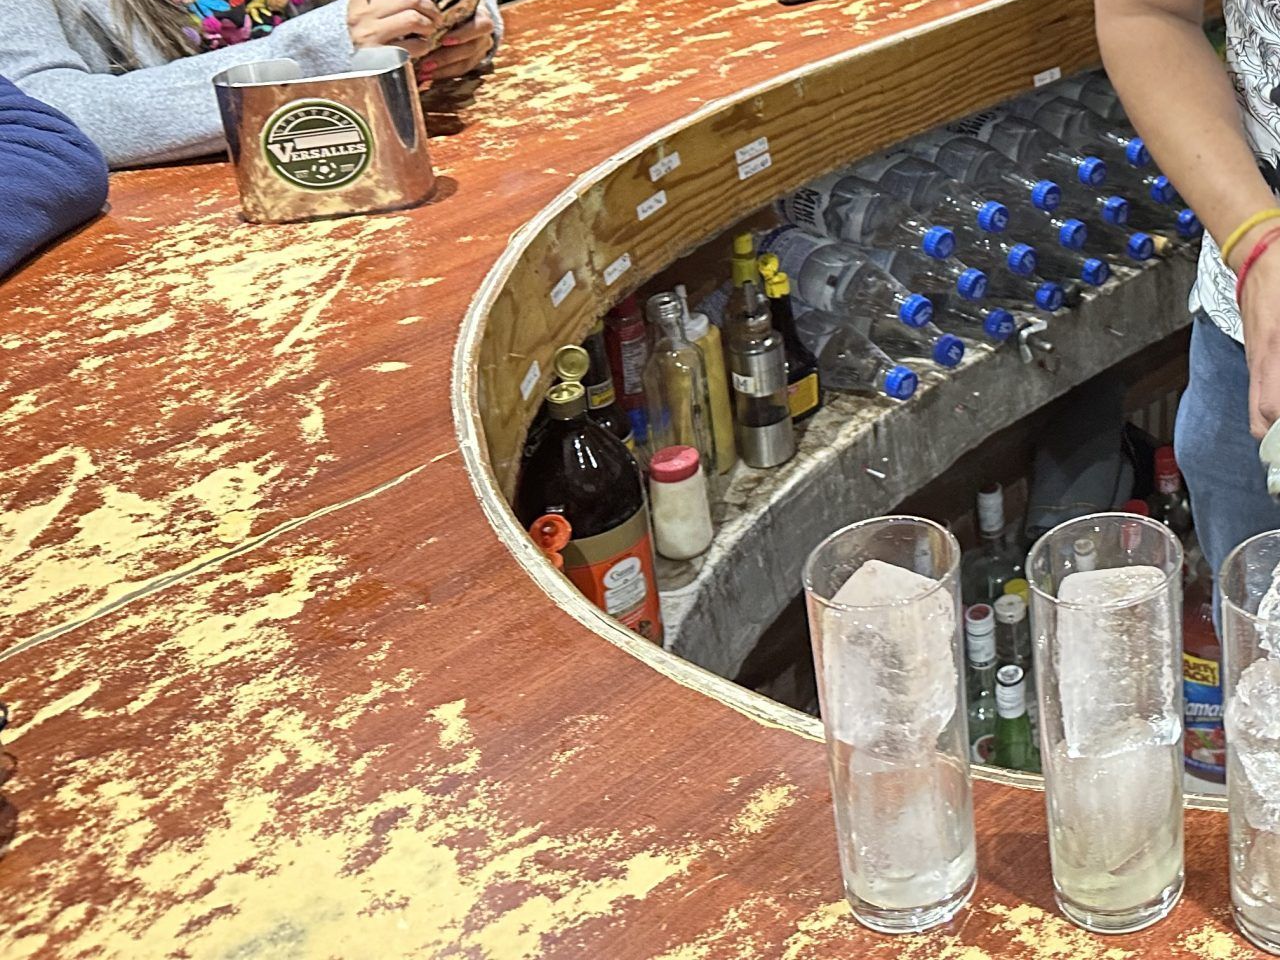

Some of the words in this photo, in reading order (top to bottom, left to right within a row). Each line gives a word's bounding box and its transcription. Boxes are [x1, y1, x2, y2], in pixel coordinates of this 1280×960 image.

[266, 142, 367, 163] VERSALLES
[1183, 658, 1217, 673] ARTY
[1183, 669, 1217, 686] ACK!
[1184, 701, 1225, 717] ama
